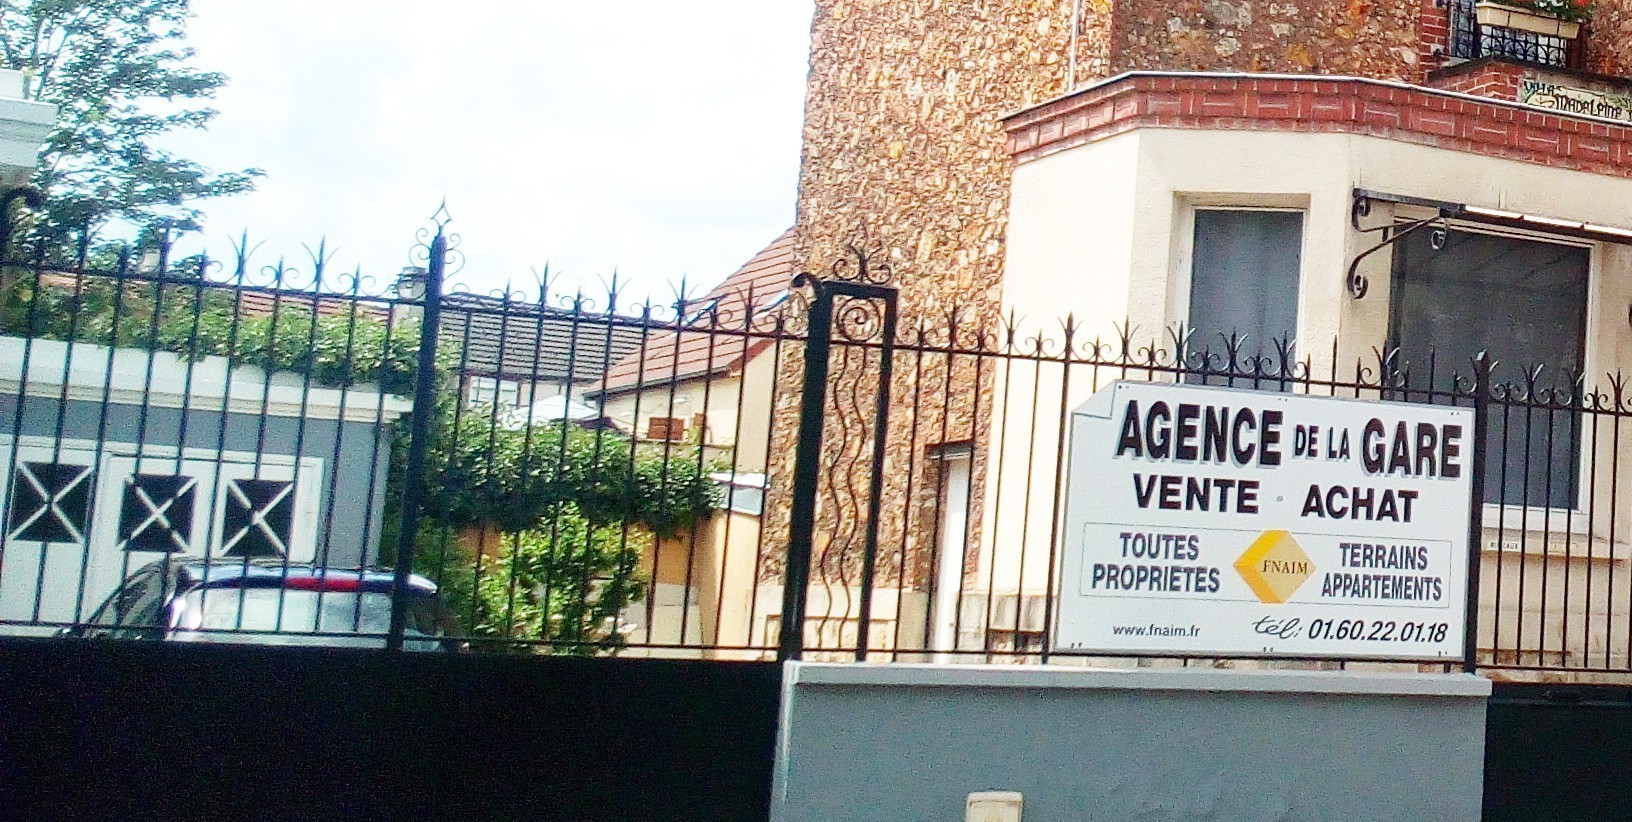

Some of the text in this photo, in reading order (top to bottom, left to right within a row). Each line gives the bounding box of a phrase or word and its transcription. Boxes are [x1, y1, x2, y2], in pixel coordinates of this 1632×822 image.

[1115, 399, 1463, 479] AGENCE DE LA GARE
[1133, 473, 1419, 523] VENTE ACHAT
[1119, 532, 1200, 561] TOUTES
[1339, 542, 1428, 571] TERRAINS
[1091, 563, 1221, 593] PROPRIETES
[1262, 559, 1308, 575] FNAIM
[1321, 572, 1442, 602] APPARTEMENTS
[1112, 623, 1201, 637] www.fnaim.fr
[1308, 618, 1449, 643] 01.60.22.01.18
